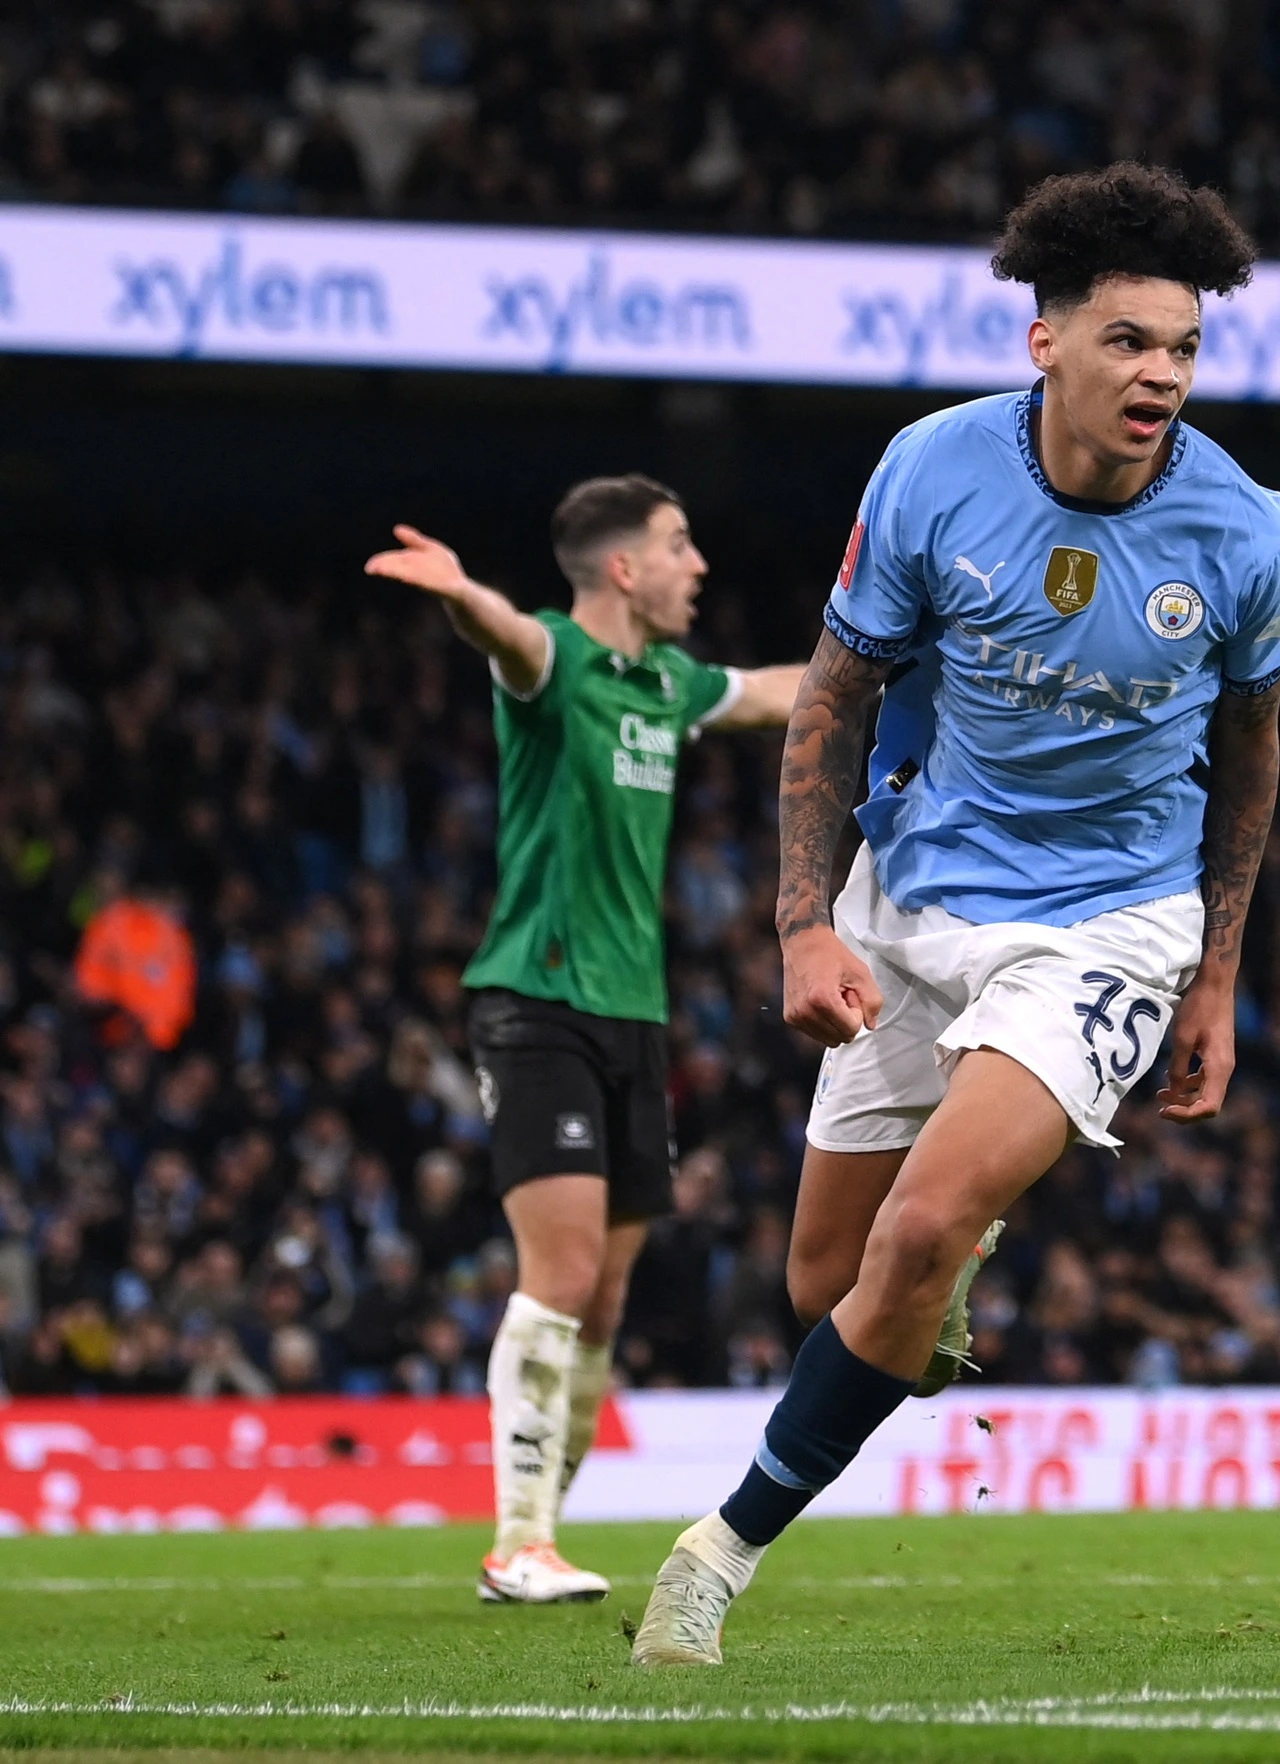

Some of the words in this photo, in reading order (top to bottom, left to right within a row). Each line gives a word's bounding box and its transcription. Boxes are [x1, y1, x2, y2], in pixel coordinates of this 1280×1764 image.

[113, 223, 389, 358] xylem
[482, 242, 750, 374] xylem
[840, 262, 1034, 388] xyle
[1056, 589, 1079, 601] FIFA
[1152, 585, 1201, 607] MANCHESTER
[1161, 630, 1180, 638] CITY
[972, 671, 1117, 730] AIRWAYS
[1074, 970, 1161, 1081] 75
